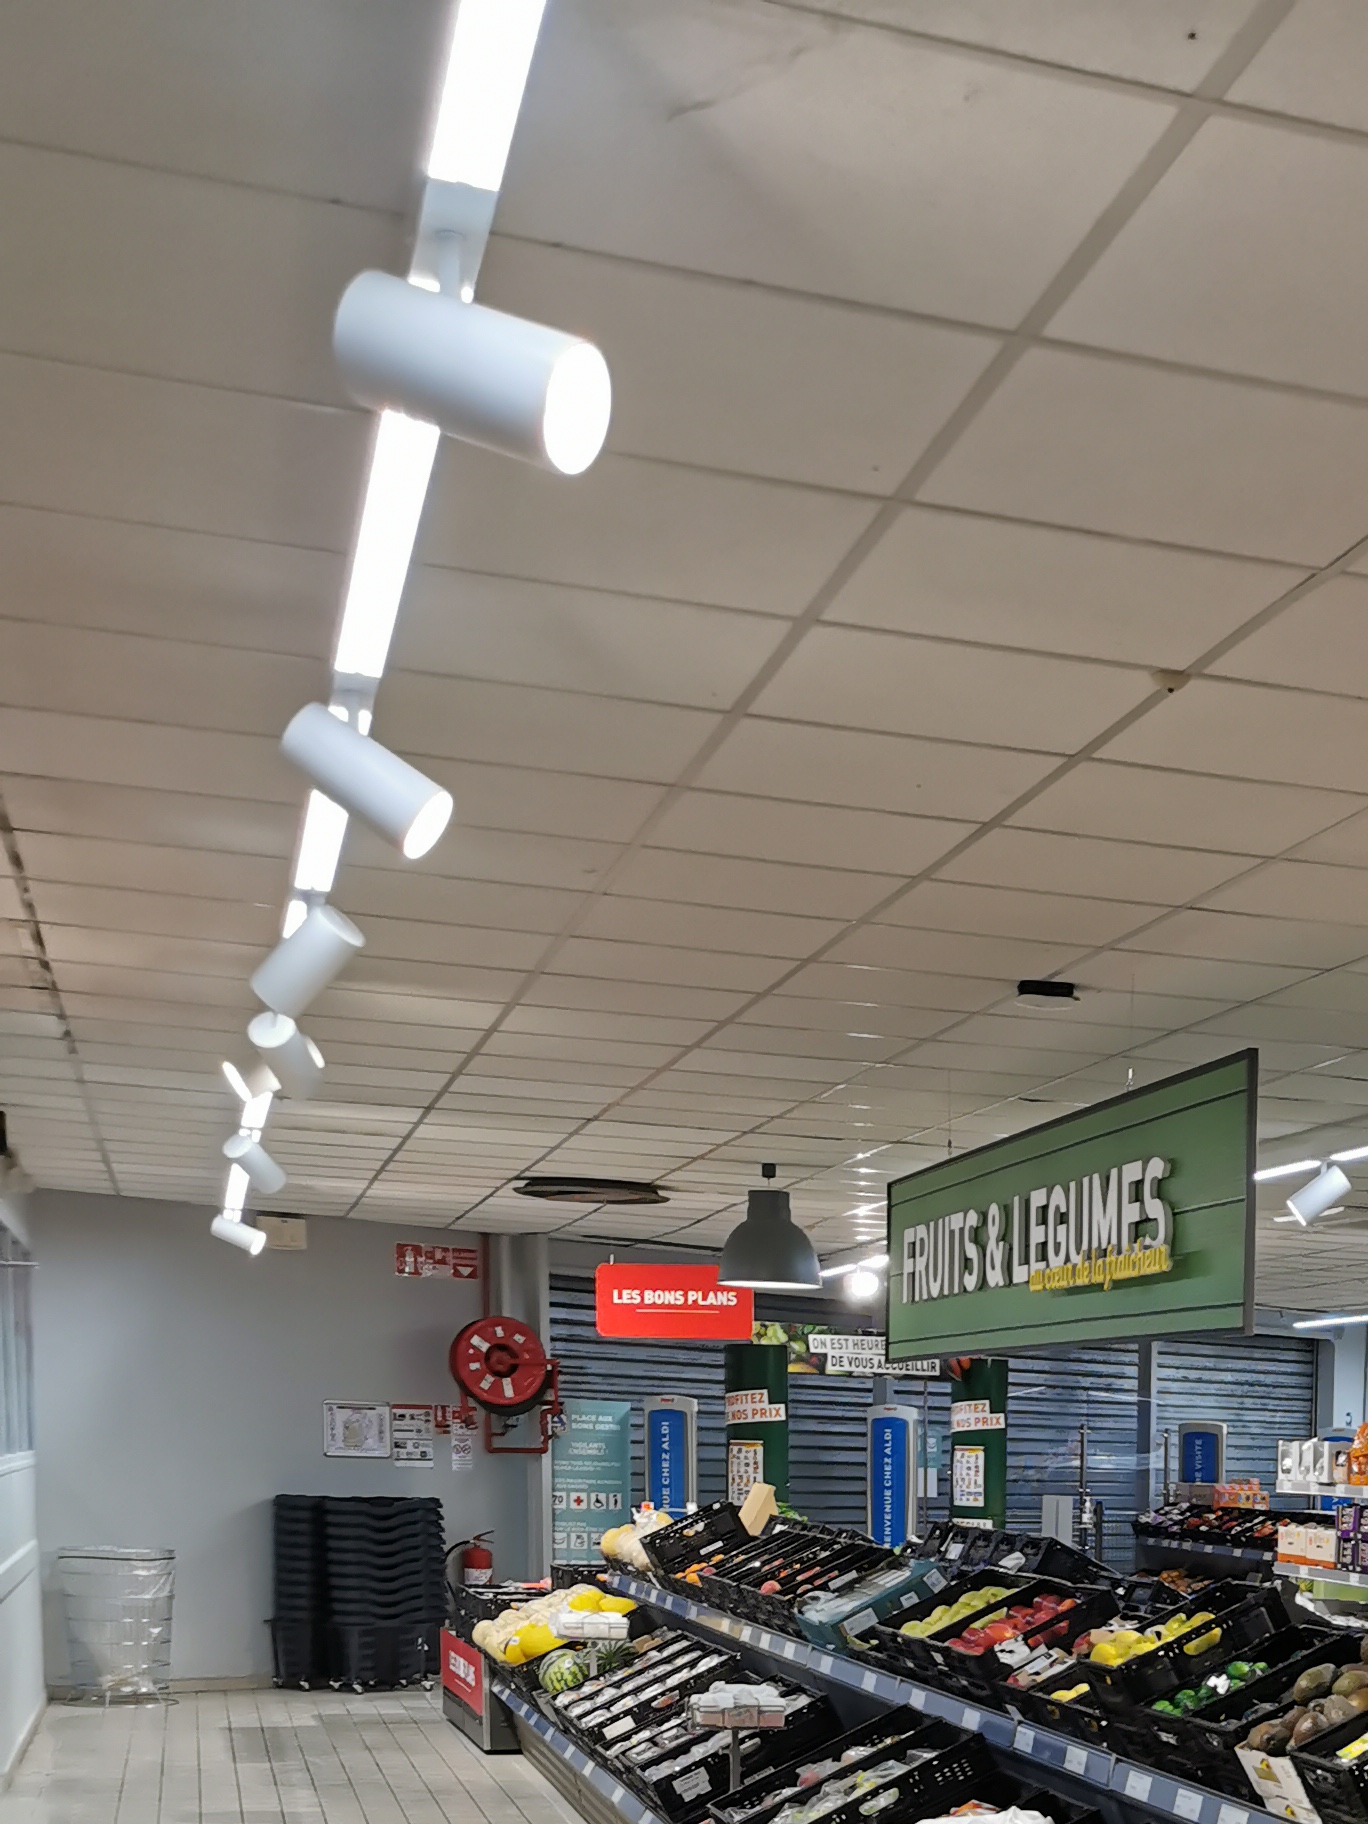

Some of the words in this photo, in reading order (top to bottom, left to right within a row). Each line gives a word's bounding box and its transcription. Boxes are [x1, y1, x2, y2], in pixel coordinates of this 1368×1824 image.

[902, 1209, 980, 1303] FRUITS
[985, 1202, 1005, 1288] &
[1012, 1156, 1168, 1284] LEGUMES
[1075, 1249, 1090, 1285] de
[1091, 1247, 1105, 1284] la
[612, 1289, 642, 1304] LES
[643, 1289, 685, 1305] BONS
[687, 1290, 738, 1306] PLANS
[812, 1338, 828, 1350] ON
[830, 1338, 849, 1351] EST
[852, 1338, 886, 1351] HEURE
[831, 1355, 845, 1368] DE
[846, 1356, 875, 1370] VOUS
[751, 1406, 782, 1419] PRIX
[974, 1415, 1001, 1427] PRIX
[660, 1421, 670, 1449] ALDI
[883, 1428, 892, 1456] ALDI
[660, 1453, 670, 1485] CHEZ
[883, 1457, 892, 1487] CHEZ
